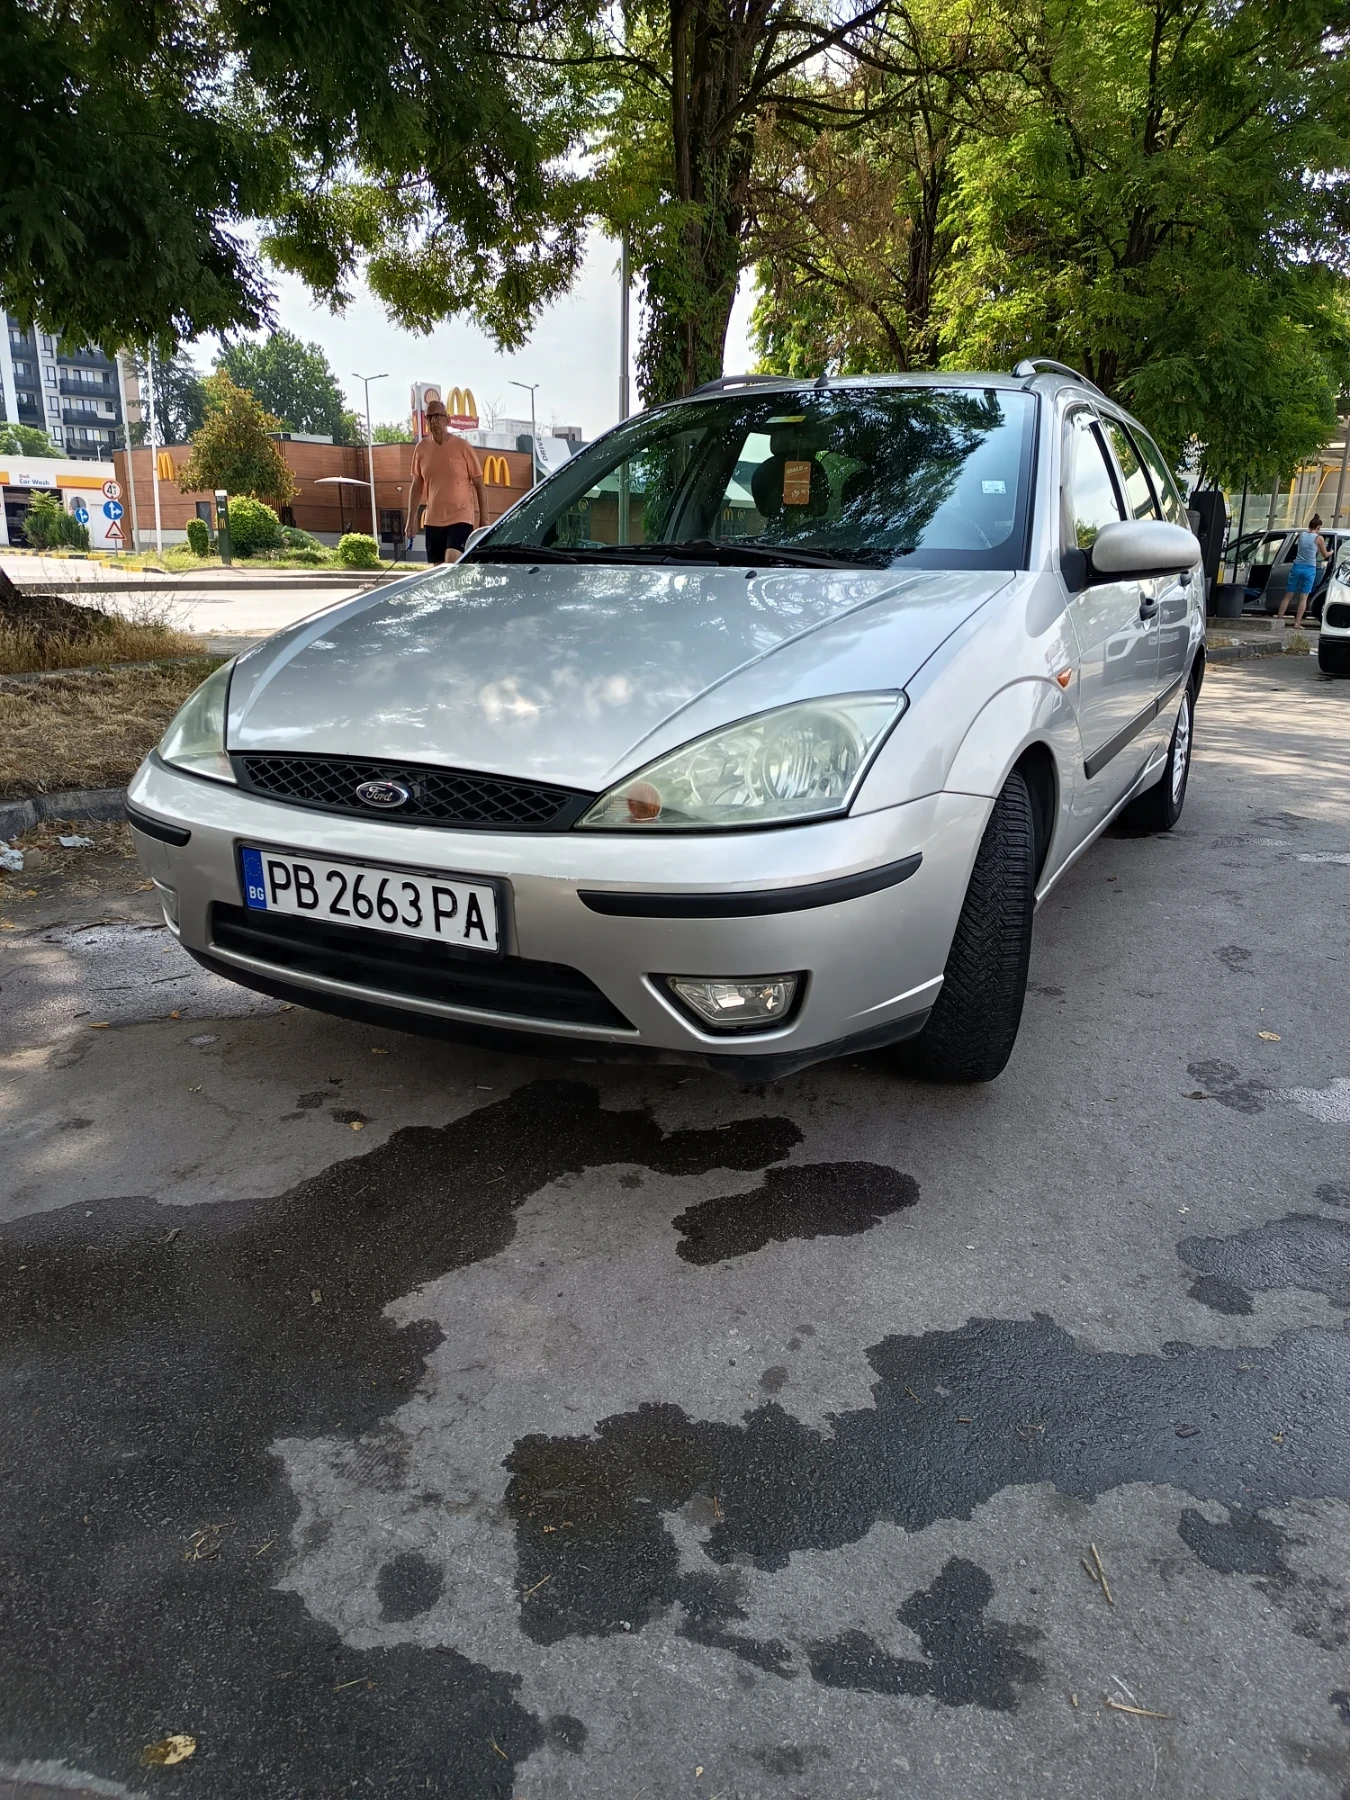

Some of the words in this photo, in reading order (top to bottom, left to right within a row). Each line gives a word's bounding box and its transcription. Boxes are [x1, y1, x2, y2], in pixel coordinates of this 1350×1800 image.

[450, 419, 476, 427] McDonald's
[536, 437, 548, 462] DRIVE
[365, 785, 393, 802] Ford
[249, 885, 265, 901] BG
